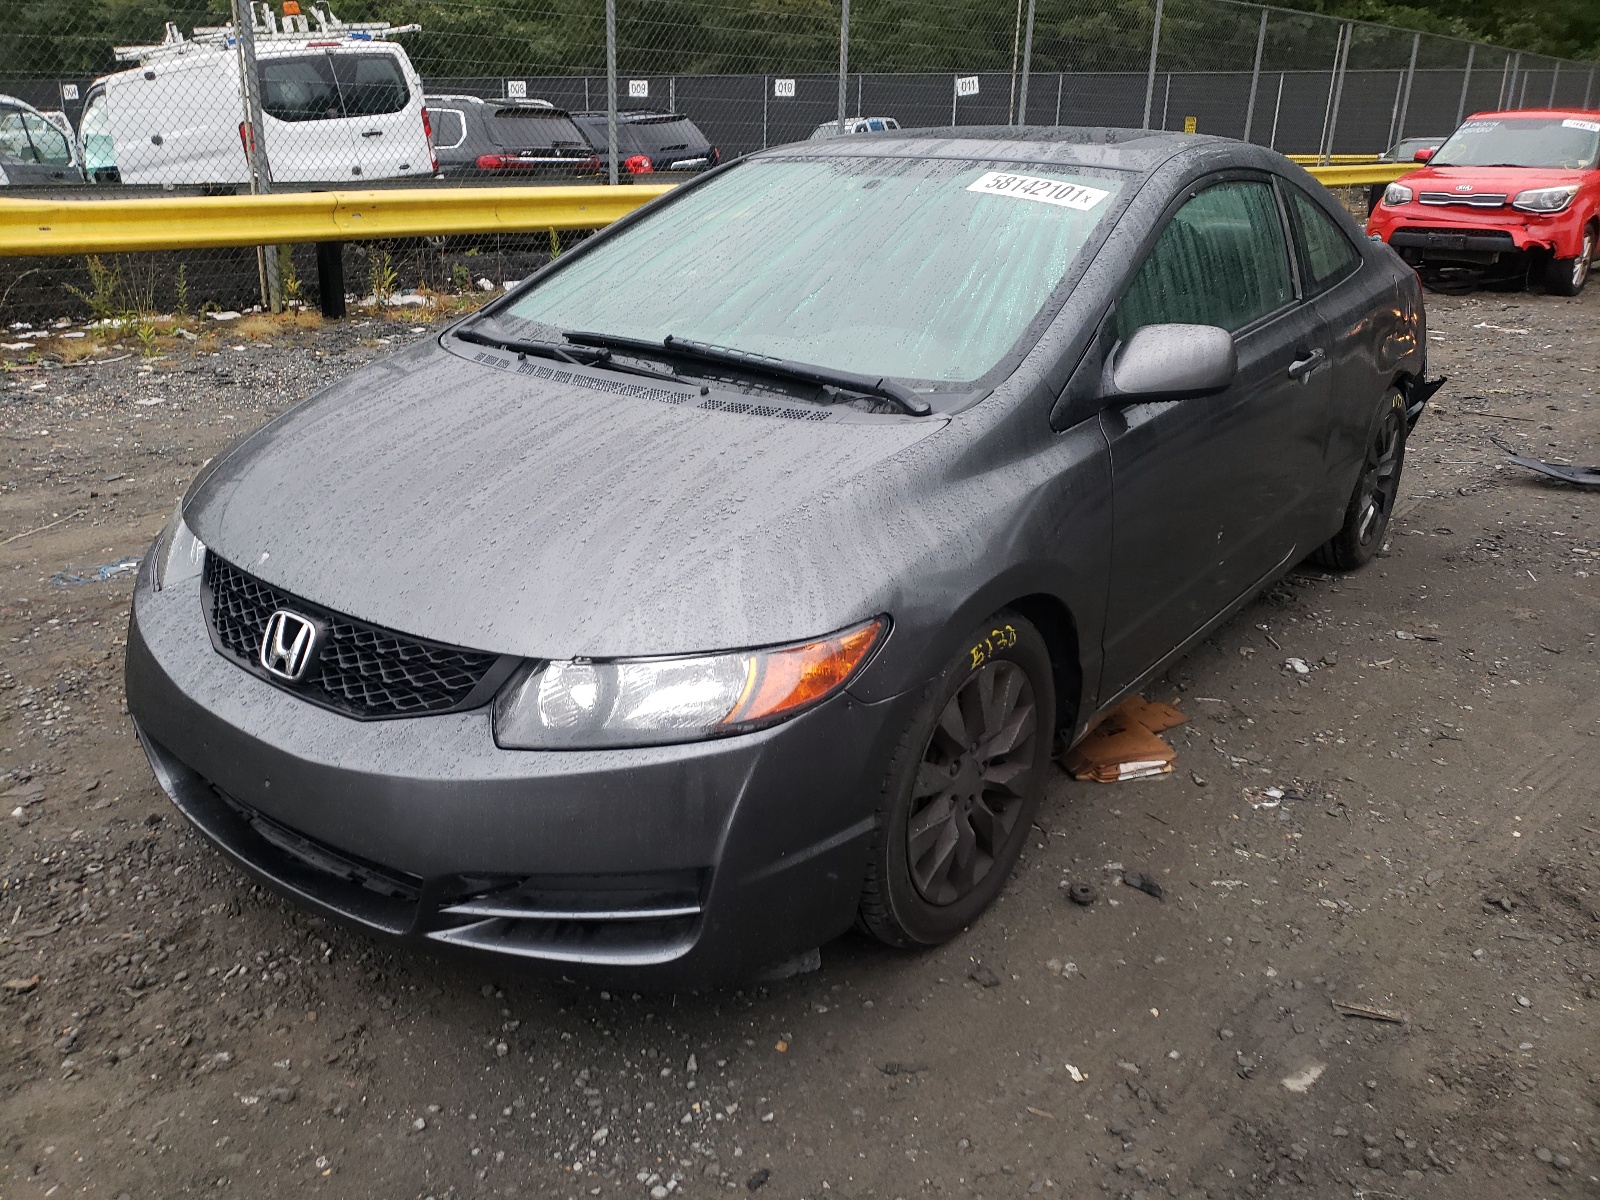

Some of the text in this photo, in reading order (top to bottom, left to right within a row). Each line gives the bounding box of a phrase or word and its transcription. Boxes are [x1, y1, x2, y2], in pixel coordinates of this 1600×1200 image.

[631, 83, 646, 94] 009
[777, 82, 793, 94] 010
[961, 80, 975, 92] 011
